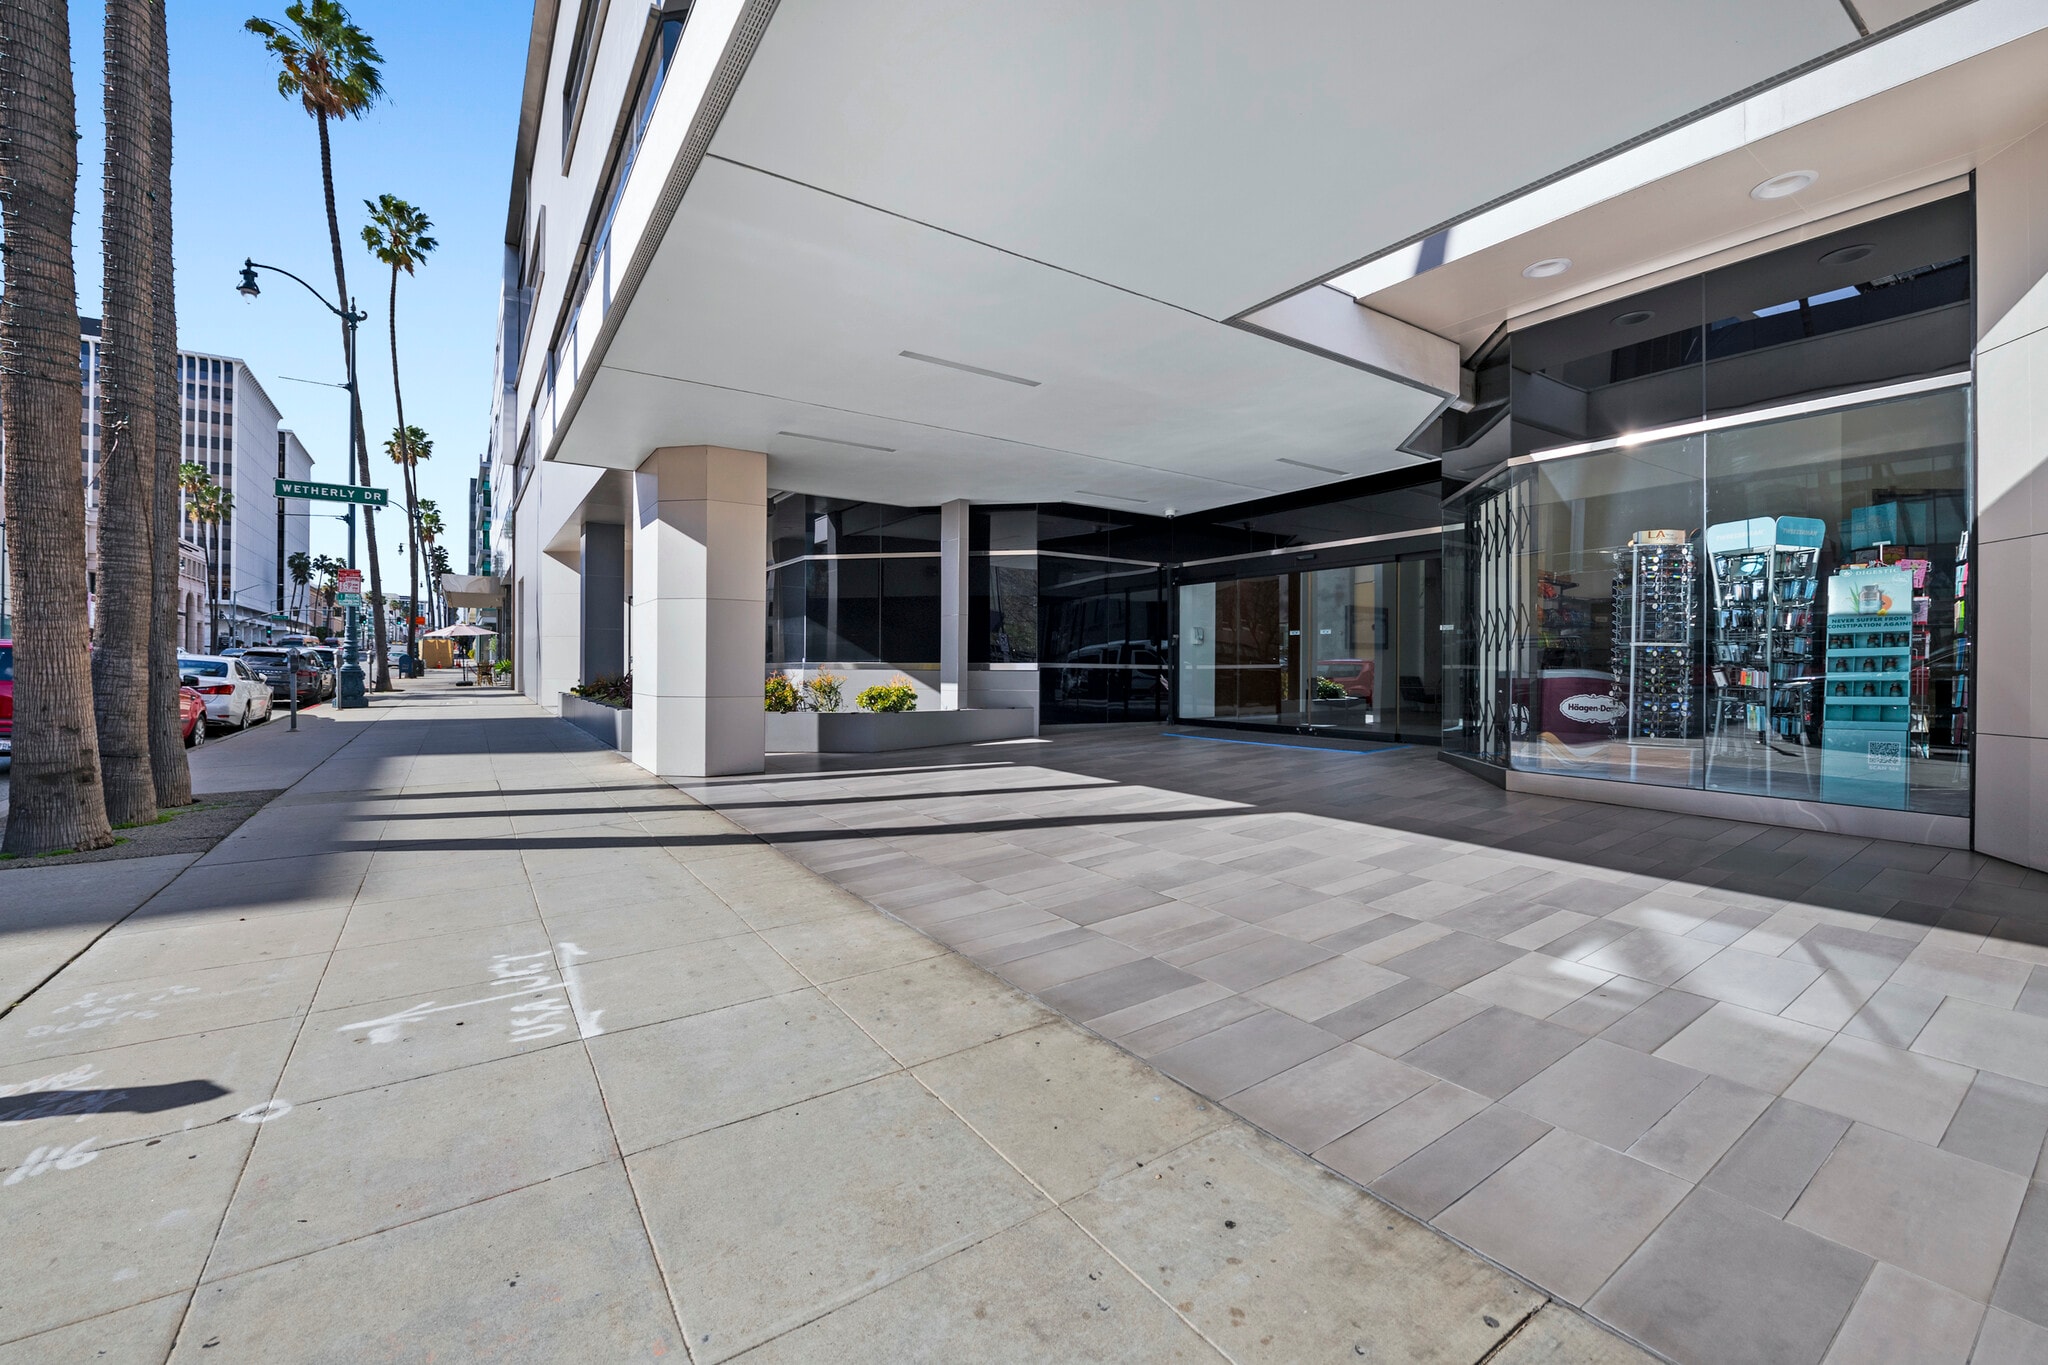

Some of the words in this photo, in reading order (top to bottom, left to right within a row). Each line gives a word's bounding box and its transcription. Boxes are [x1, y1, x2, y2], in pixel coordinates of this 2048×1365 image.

[282, 484, 355, 498] WETHERLY
[364, 491, 382, 501] DR
[1568, 703, 1619, 713] Häagen-Da
[509, 998, 570, 1042] USA
